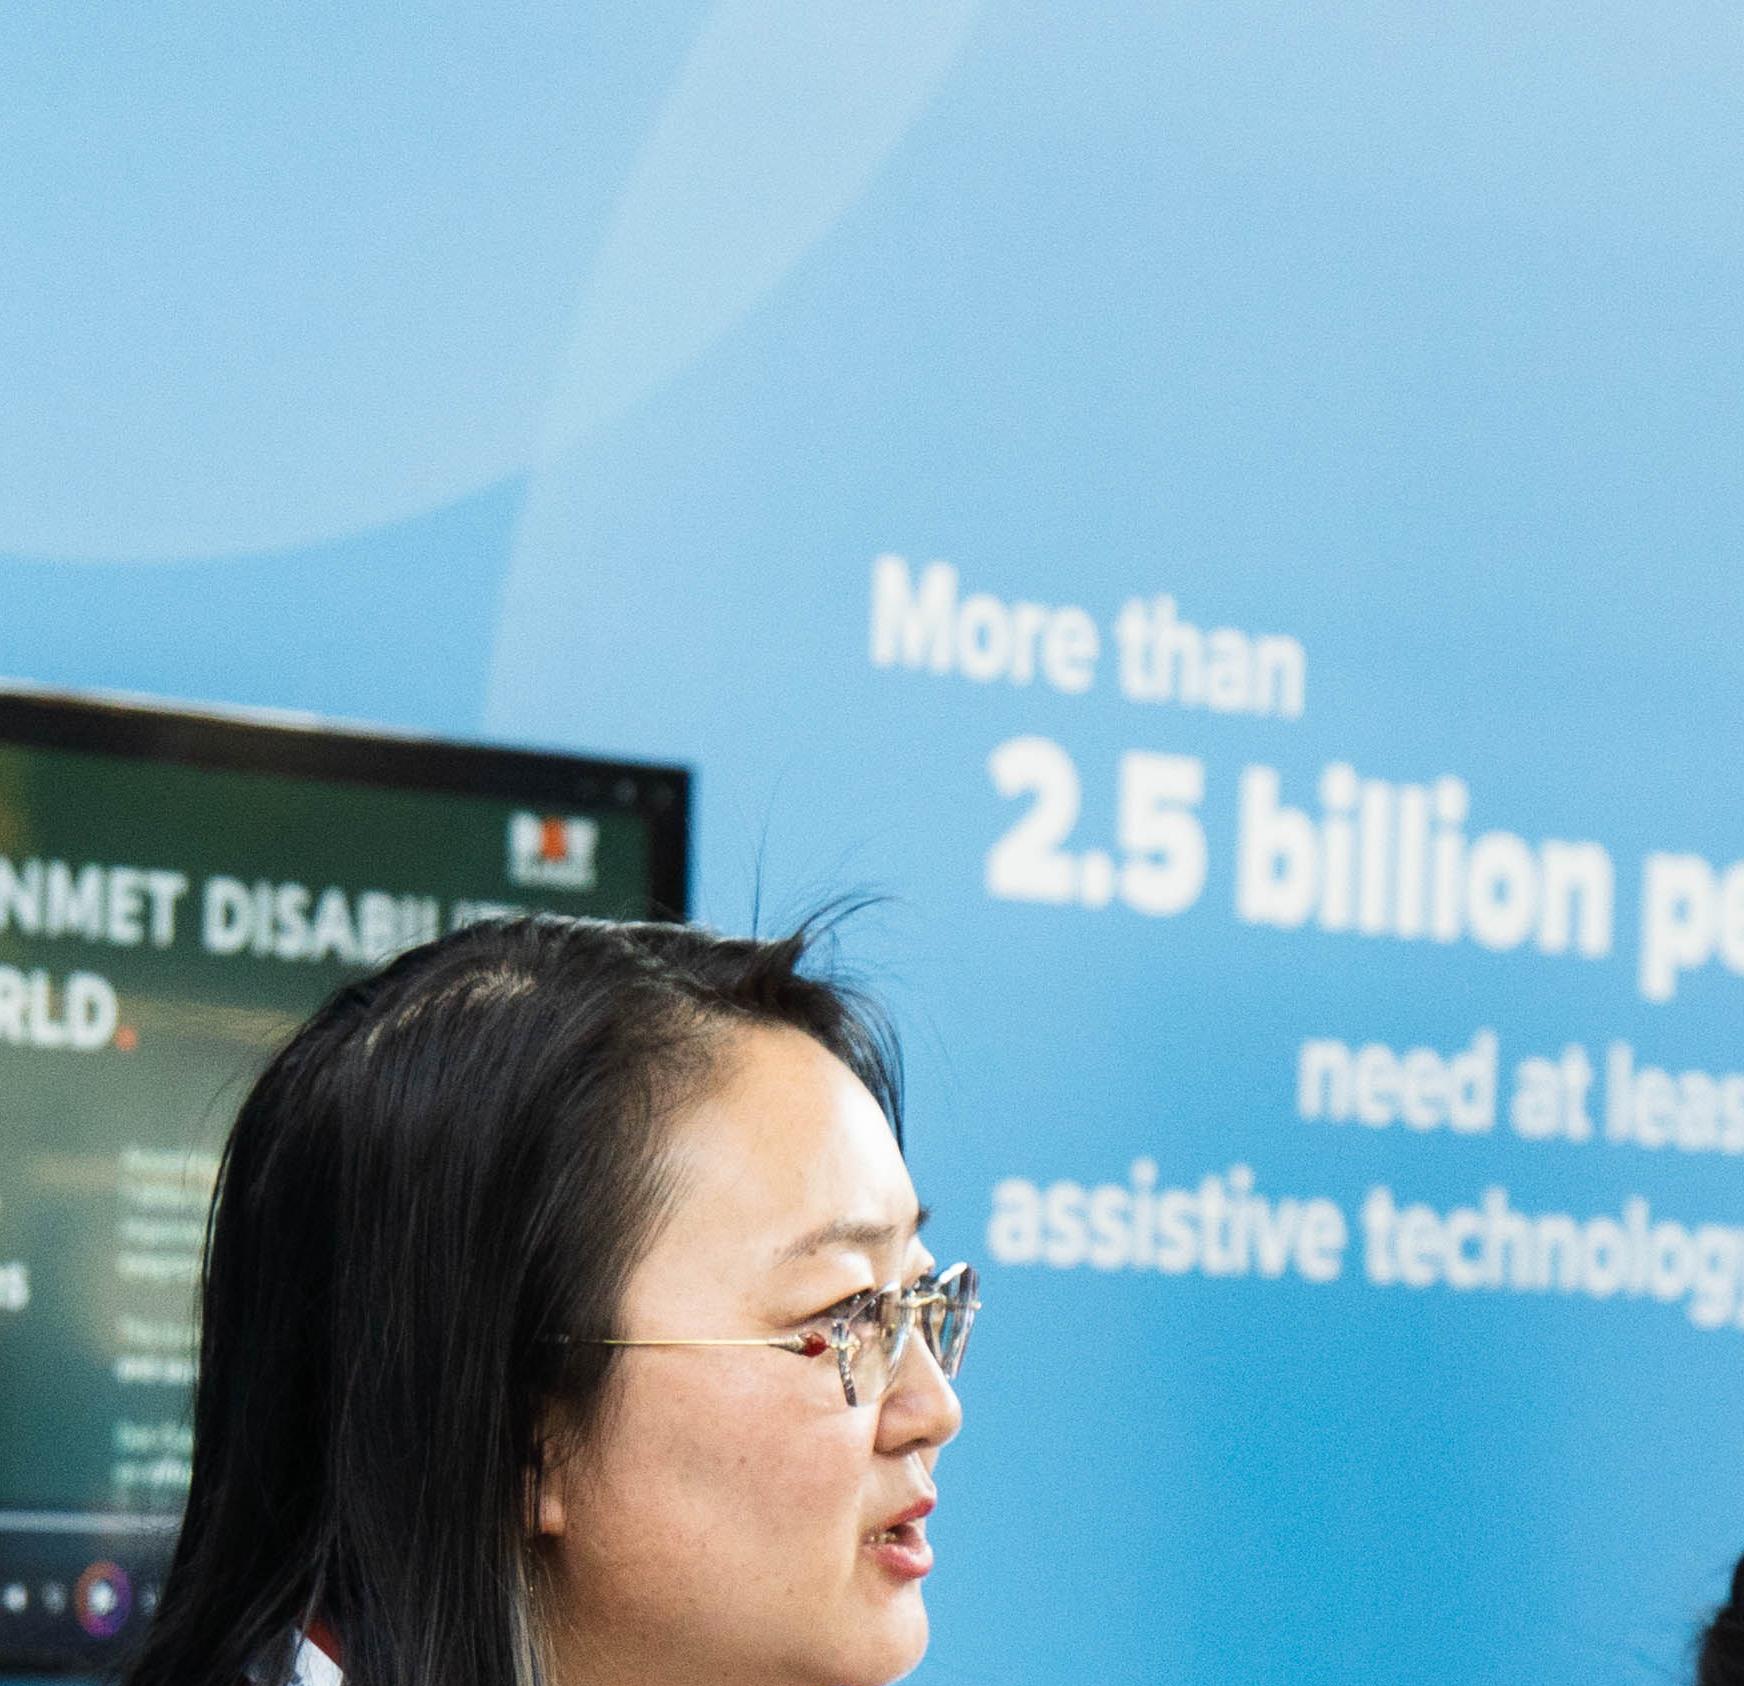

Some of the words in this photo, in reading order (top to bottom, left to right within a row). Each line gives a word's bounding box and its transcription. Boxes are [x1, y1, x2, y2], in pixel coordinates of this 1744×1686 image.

[871, 553, 1100, 693] More
[1114, 593, 1307, 721] than
[986, 735, 1208, 916] 2.5
[1236, 762, 1613, 957] billion
[1298, 1026, 1499, 1133] need
[1509, 1041, 1595, 1143] at
[986, 1158, 1346, 1284] assistive
